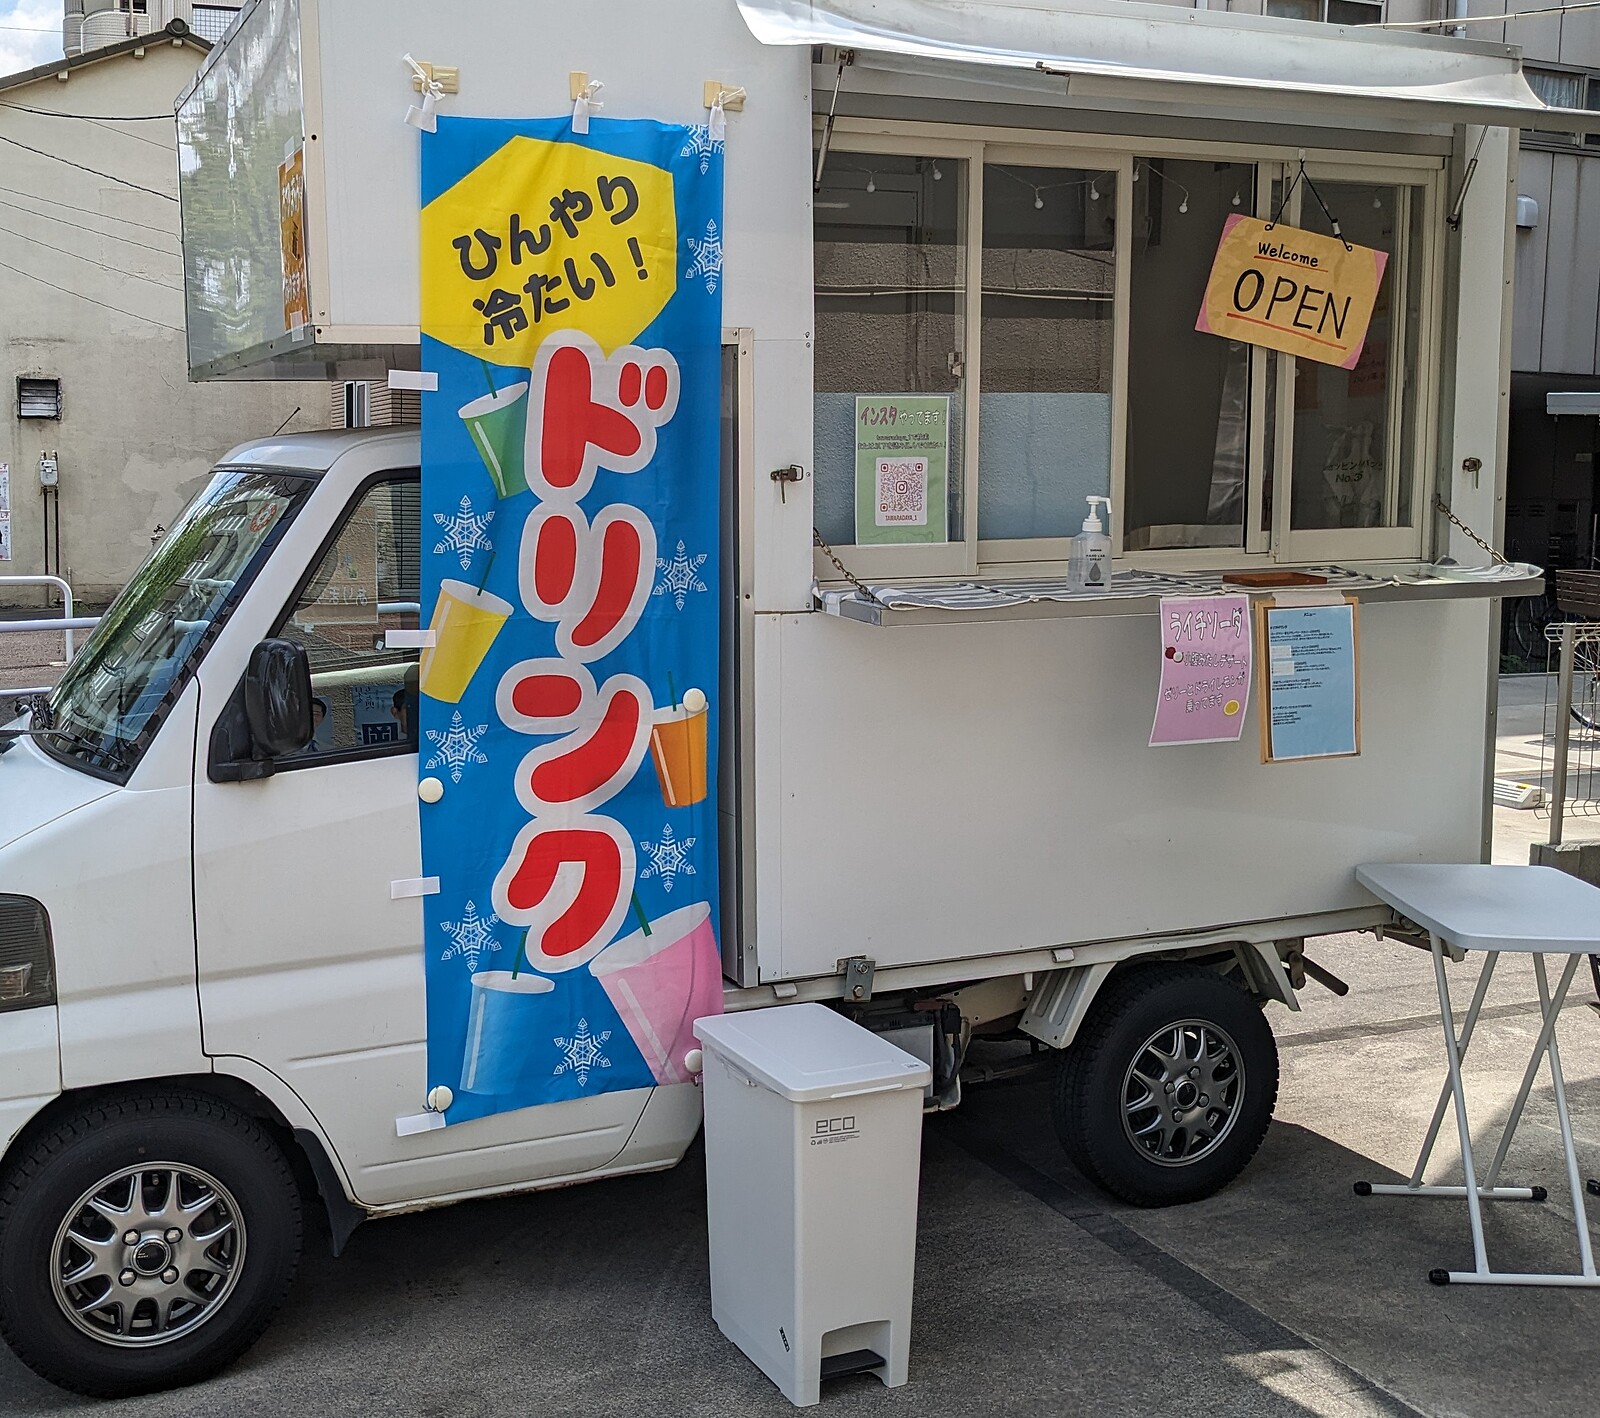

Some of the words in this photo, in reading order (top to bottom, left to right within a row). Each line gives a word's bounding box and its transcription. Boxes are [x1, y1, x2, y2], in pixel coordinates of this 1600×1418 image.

[453, 175, 639, 280] ひんやり
[1257, 241, 1320, 268] Welcome
[472, 237, 649, 346] 冷たい！
[1232, 268, 1353, 340] OPEN
[506, 345, 669, 957] ドリンク
[1169, 607, 1244, 642] ライチソーダ
[815, 1116, 856, 1134] eco
